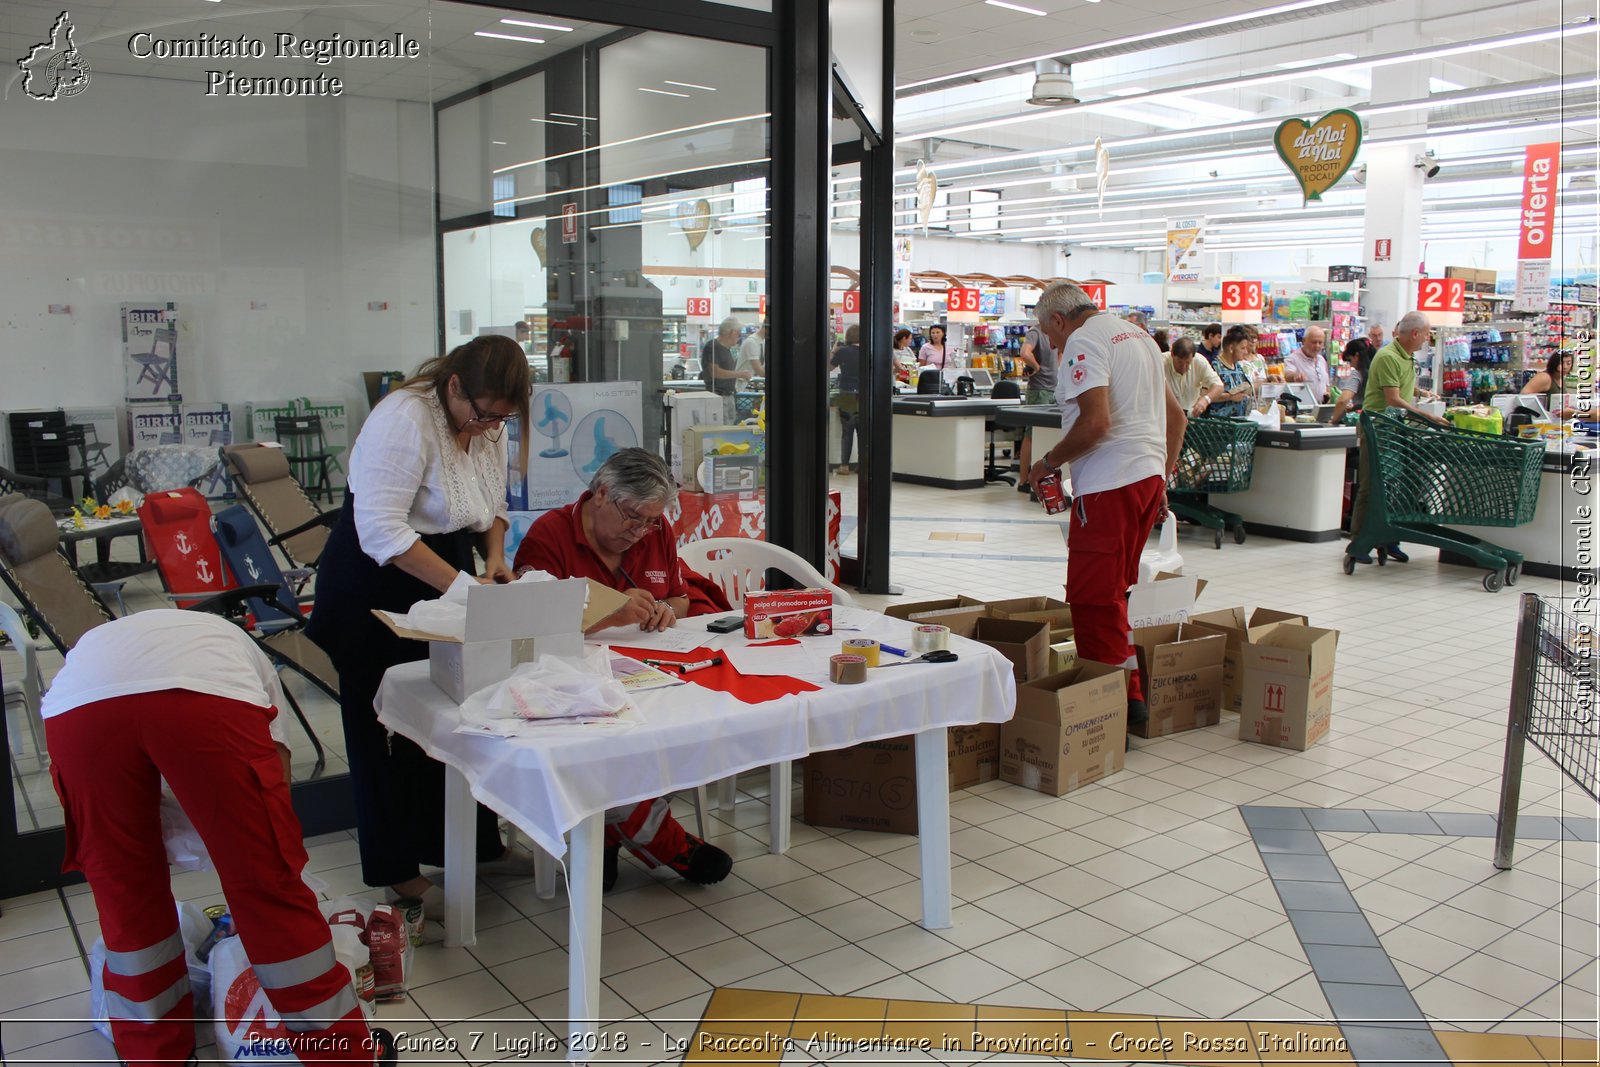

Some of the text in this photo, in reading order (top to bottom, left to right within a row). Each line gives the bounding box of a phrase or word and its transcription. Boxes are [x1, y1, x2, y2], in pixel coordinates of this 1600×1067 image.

[1300, 162, 1341, 173] PRODOTTI
[1304, 173, 1335, 182] LOCALI
[1523, 157, 1551, 245] offerta
[1182, 220, 1197, 228] COSTO
[846, 294, 854, 311] 6
[950, 291, 960, 309] 5
[966, 291, 976, 309] 5
[1092, 284, 1103, 308] 4
[1226, 284, 1241, 308] 3
[1248, 284, 1259, 308] 3
[1424, 282, 1442, 308] 2
[1450, 284, 1461, 309] 2
[699, 299, 708, 314] 8
[595, 389, 638, 398] MASTER
[136, 414, 180, 428] BIRKI
[187, 413, 228, 426] BIRKI
[753, 602, 770, 610] polpa
[778, 600, 808, 608] pomodoro
[808, 598, 828, 607] pelato
[1152, 673, 1198, 690] ZUCCHERO
[1004, 749, 1019, 761] Pan
[811, 769, 872, 801] PASTA
